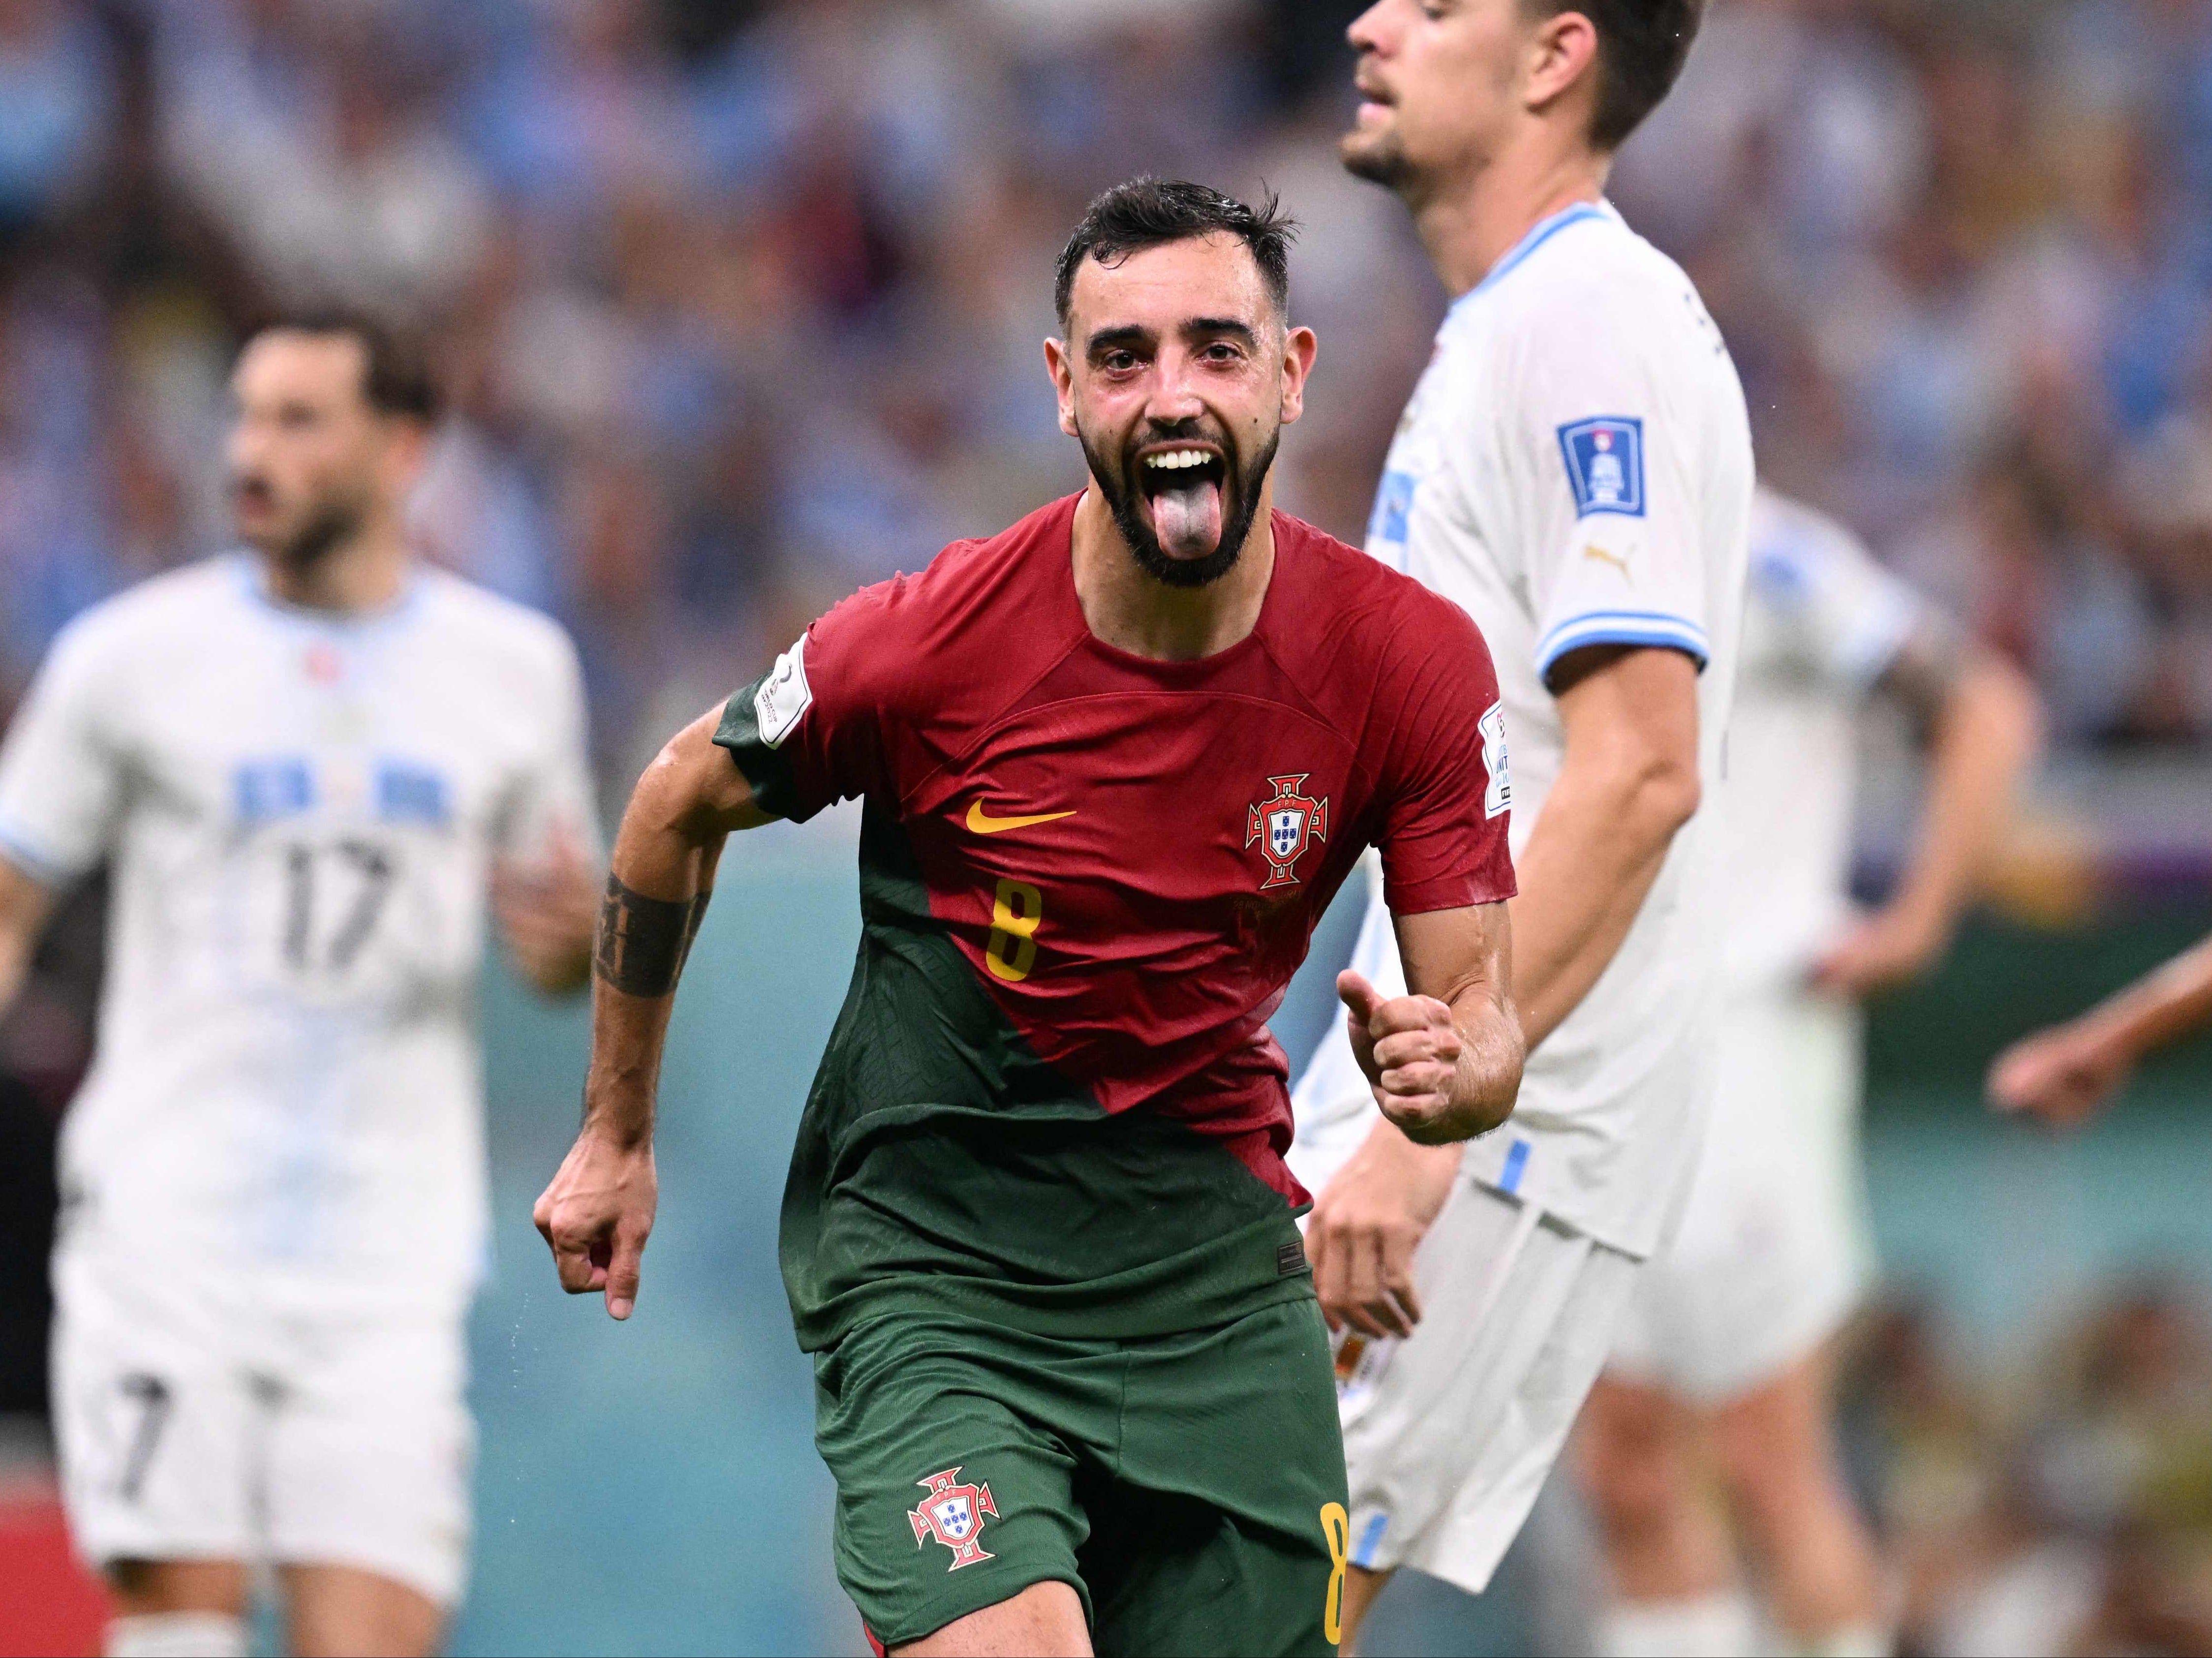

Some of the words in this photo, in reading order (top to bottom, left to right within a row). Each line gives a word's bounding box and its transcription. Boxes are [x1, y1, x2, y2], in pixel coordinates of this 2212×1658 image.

[282, 837, 398, 970] 17
[986, 878, 1042, 982] 8
[1320, 1502, 1350, 1646] 8
